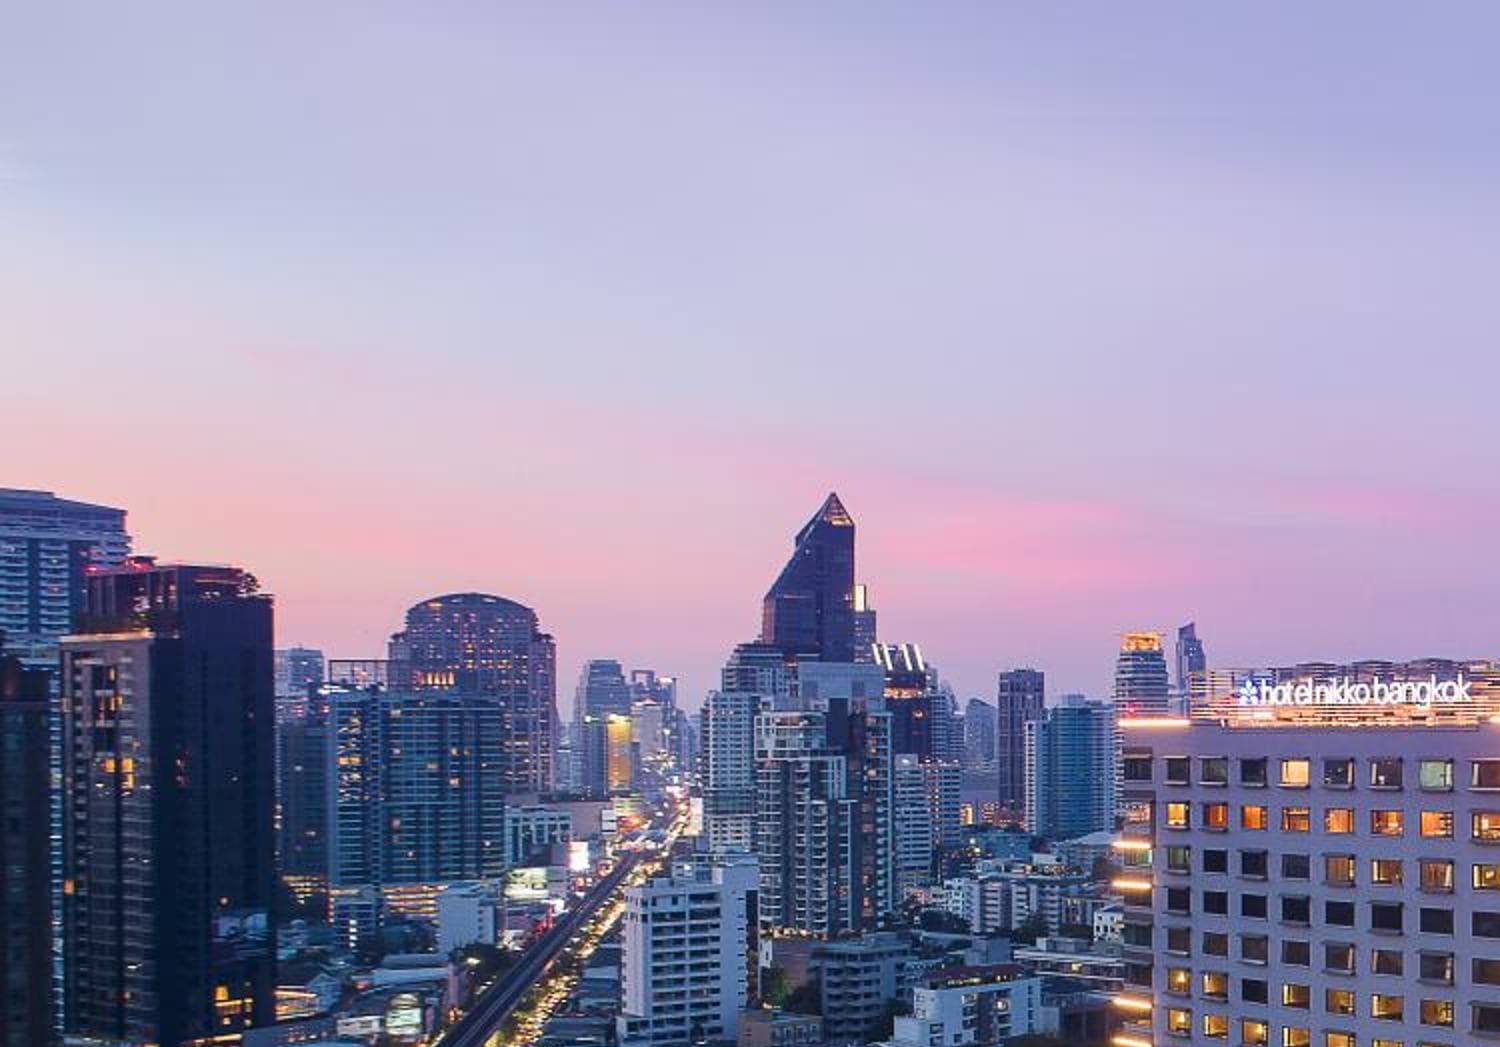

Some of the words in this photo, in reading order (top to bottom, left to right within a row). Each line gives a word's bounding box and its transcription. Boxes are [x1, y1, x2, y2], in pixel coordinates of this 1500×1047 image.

[1261, 678, 1313, 705] hotel
[1316, 676, 1370, 705] nikko
[1374, 674, 1472, 709] bangkok
